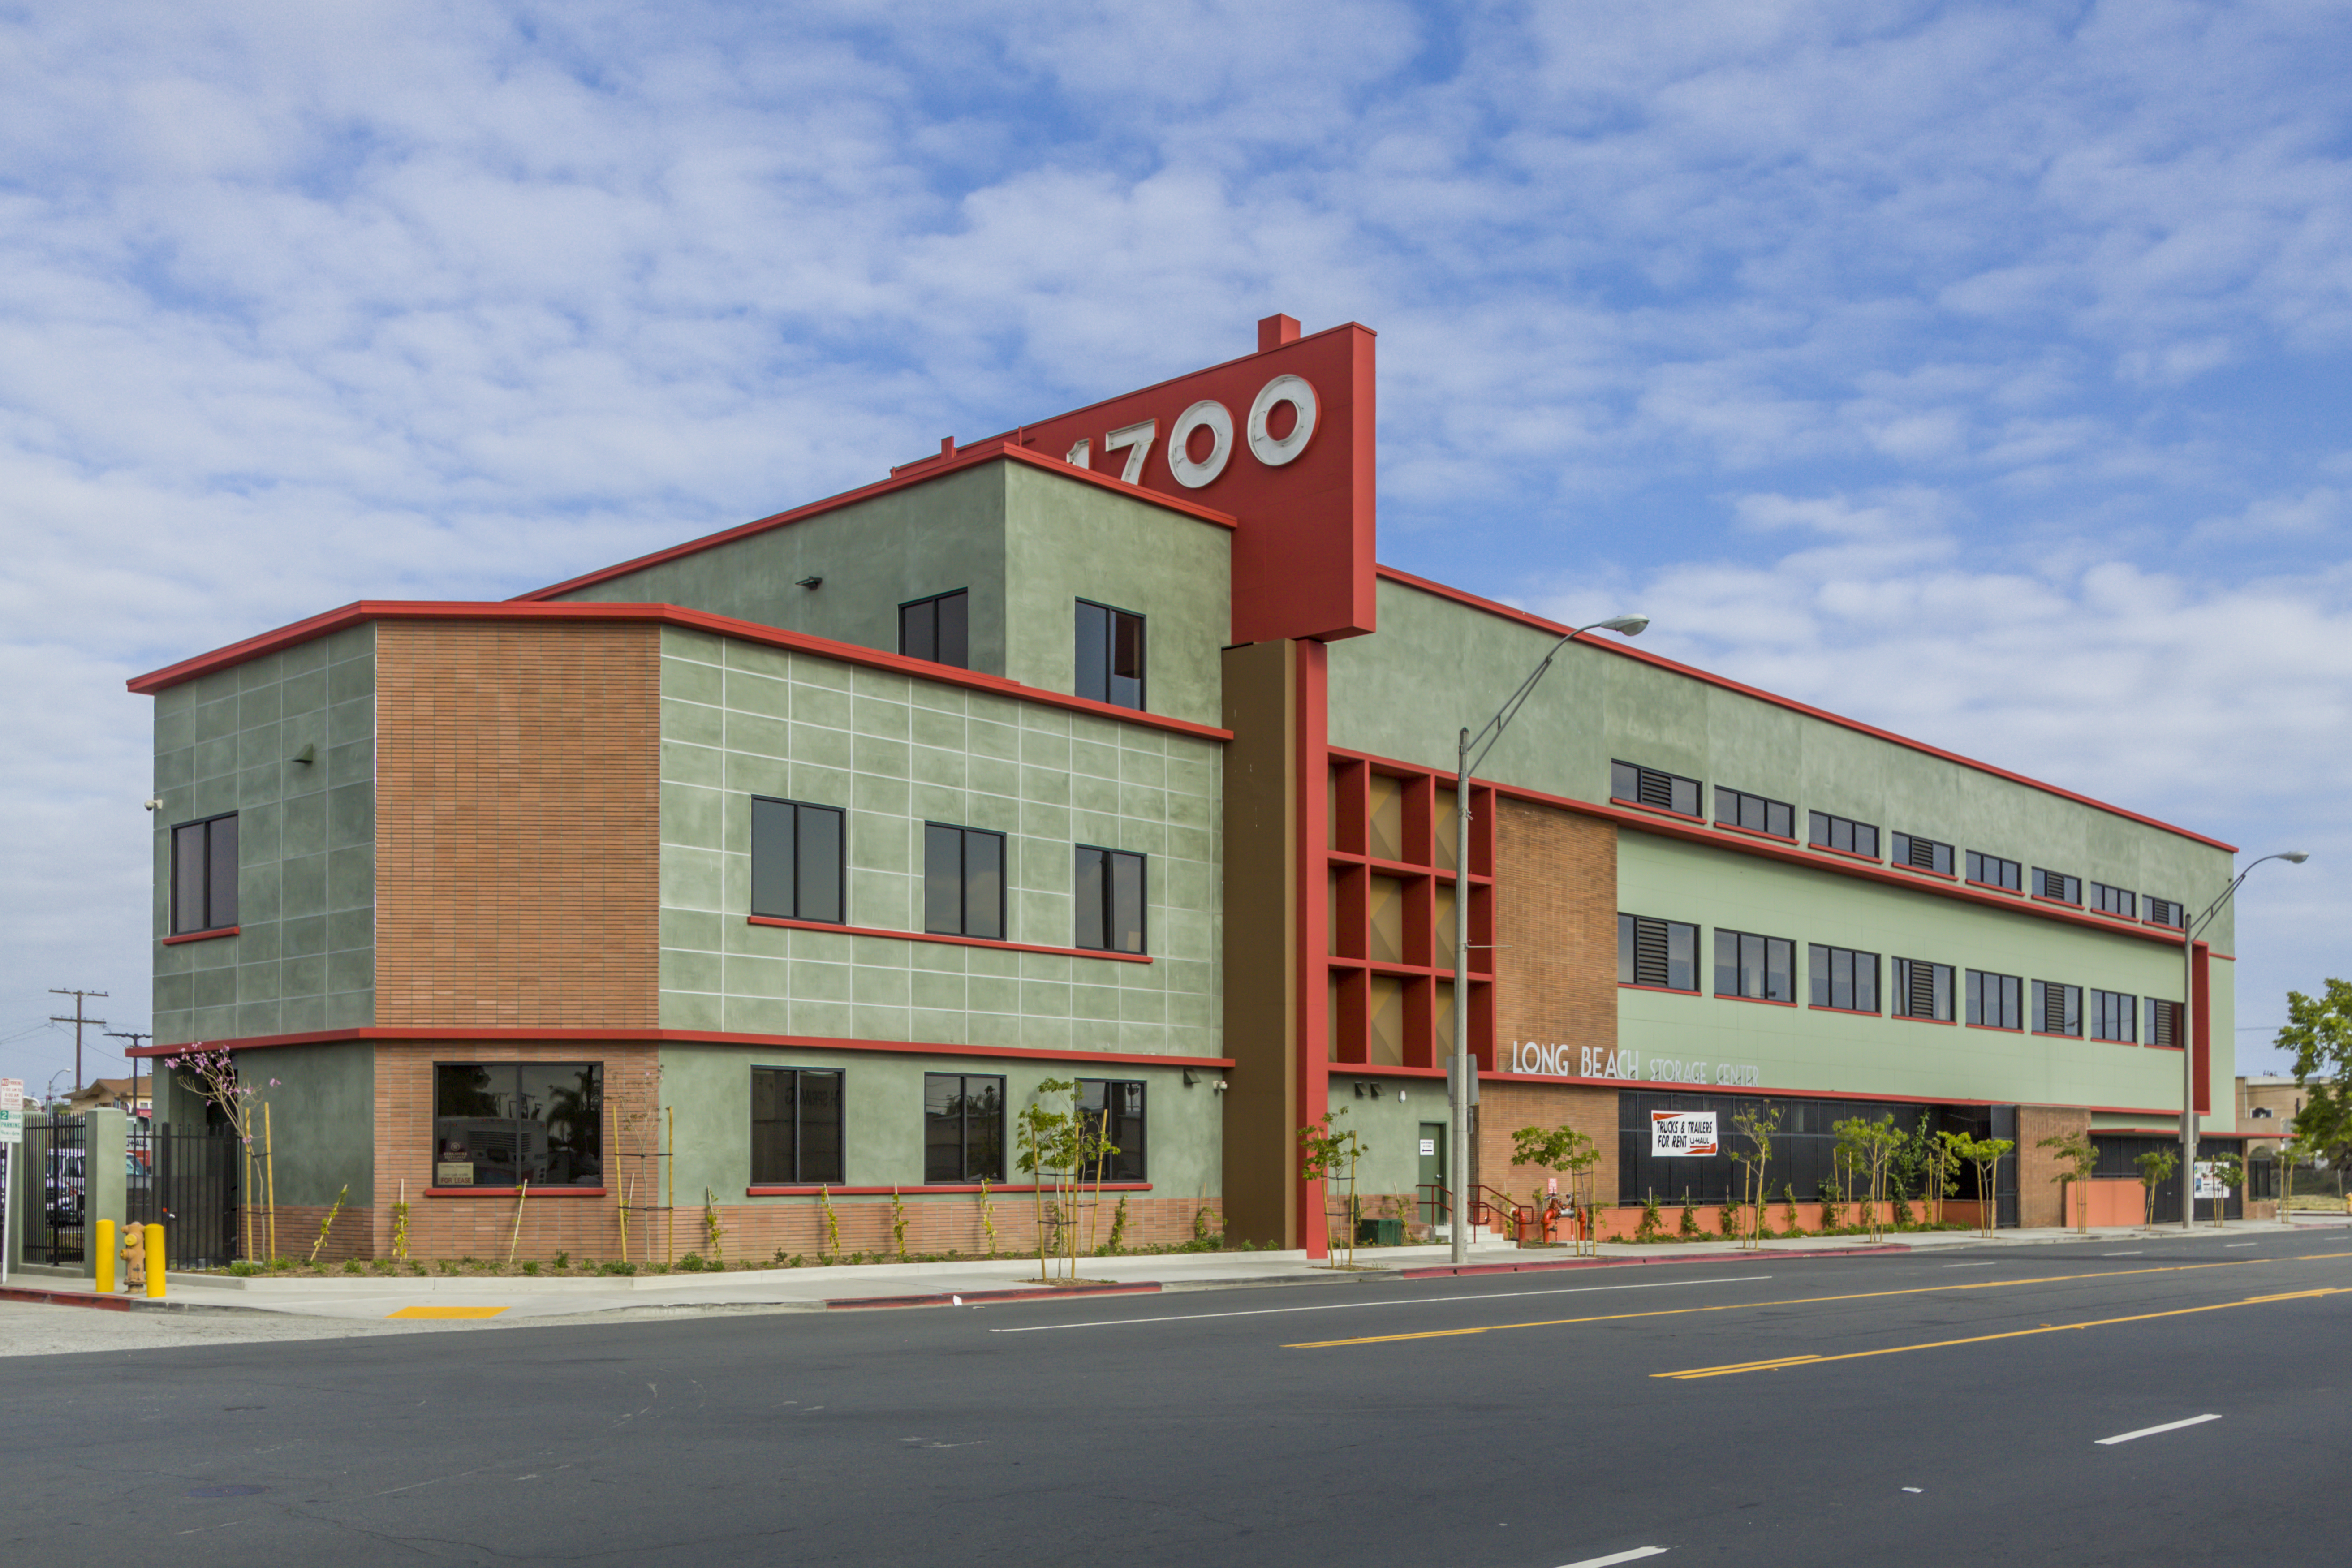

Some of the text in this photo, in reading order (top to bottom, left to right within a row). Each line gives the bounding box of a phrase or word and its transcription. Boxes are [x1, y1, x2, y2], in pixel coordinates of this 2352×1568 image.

[1513, 1041, 1759, 1087] LONG BEACH STORAGE CENTER
[1657, 1121, 1712, 1134] TRUCKS & TRAILERS
[1658, 1135, 1687, 1148] FOR RENT
